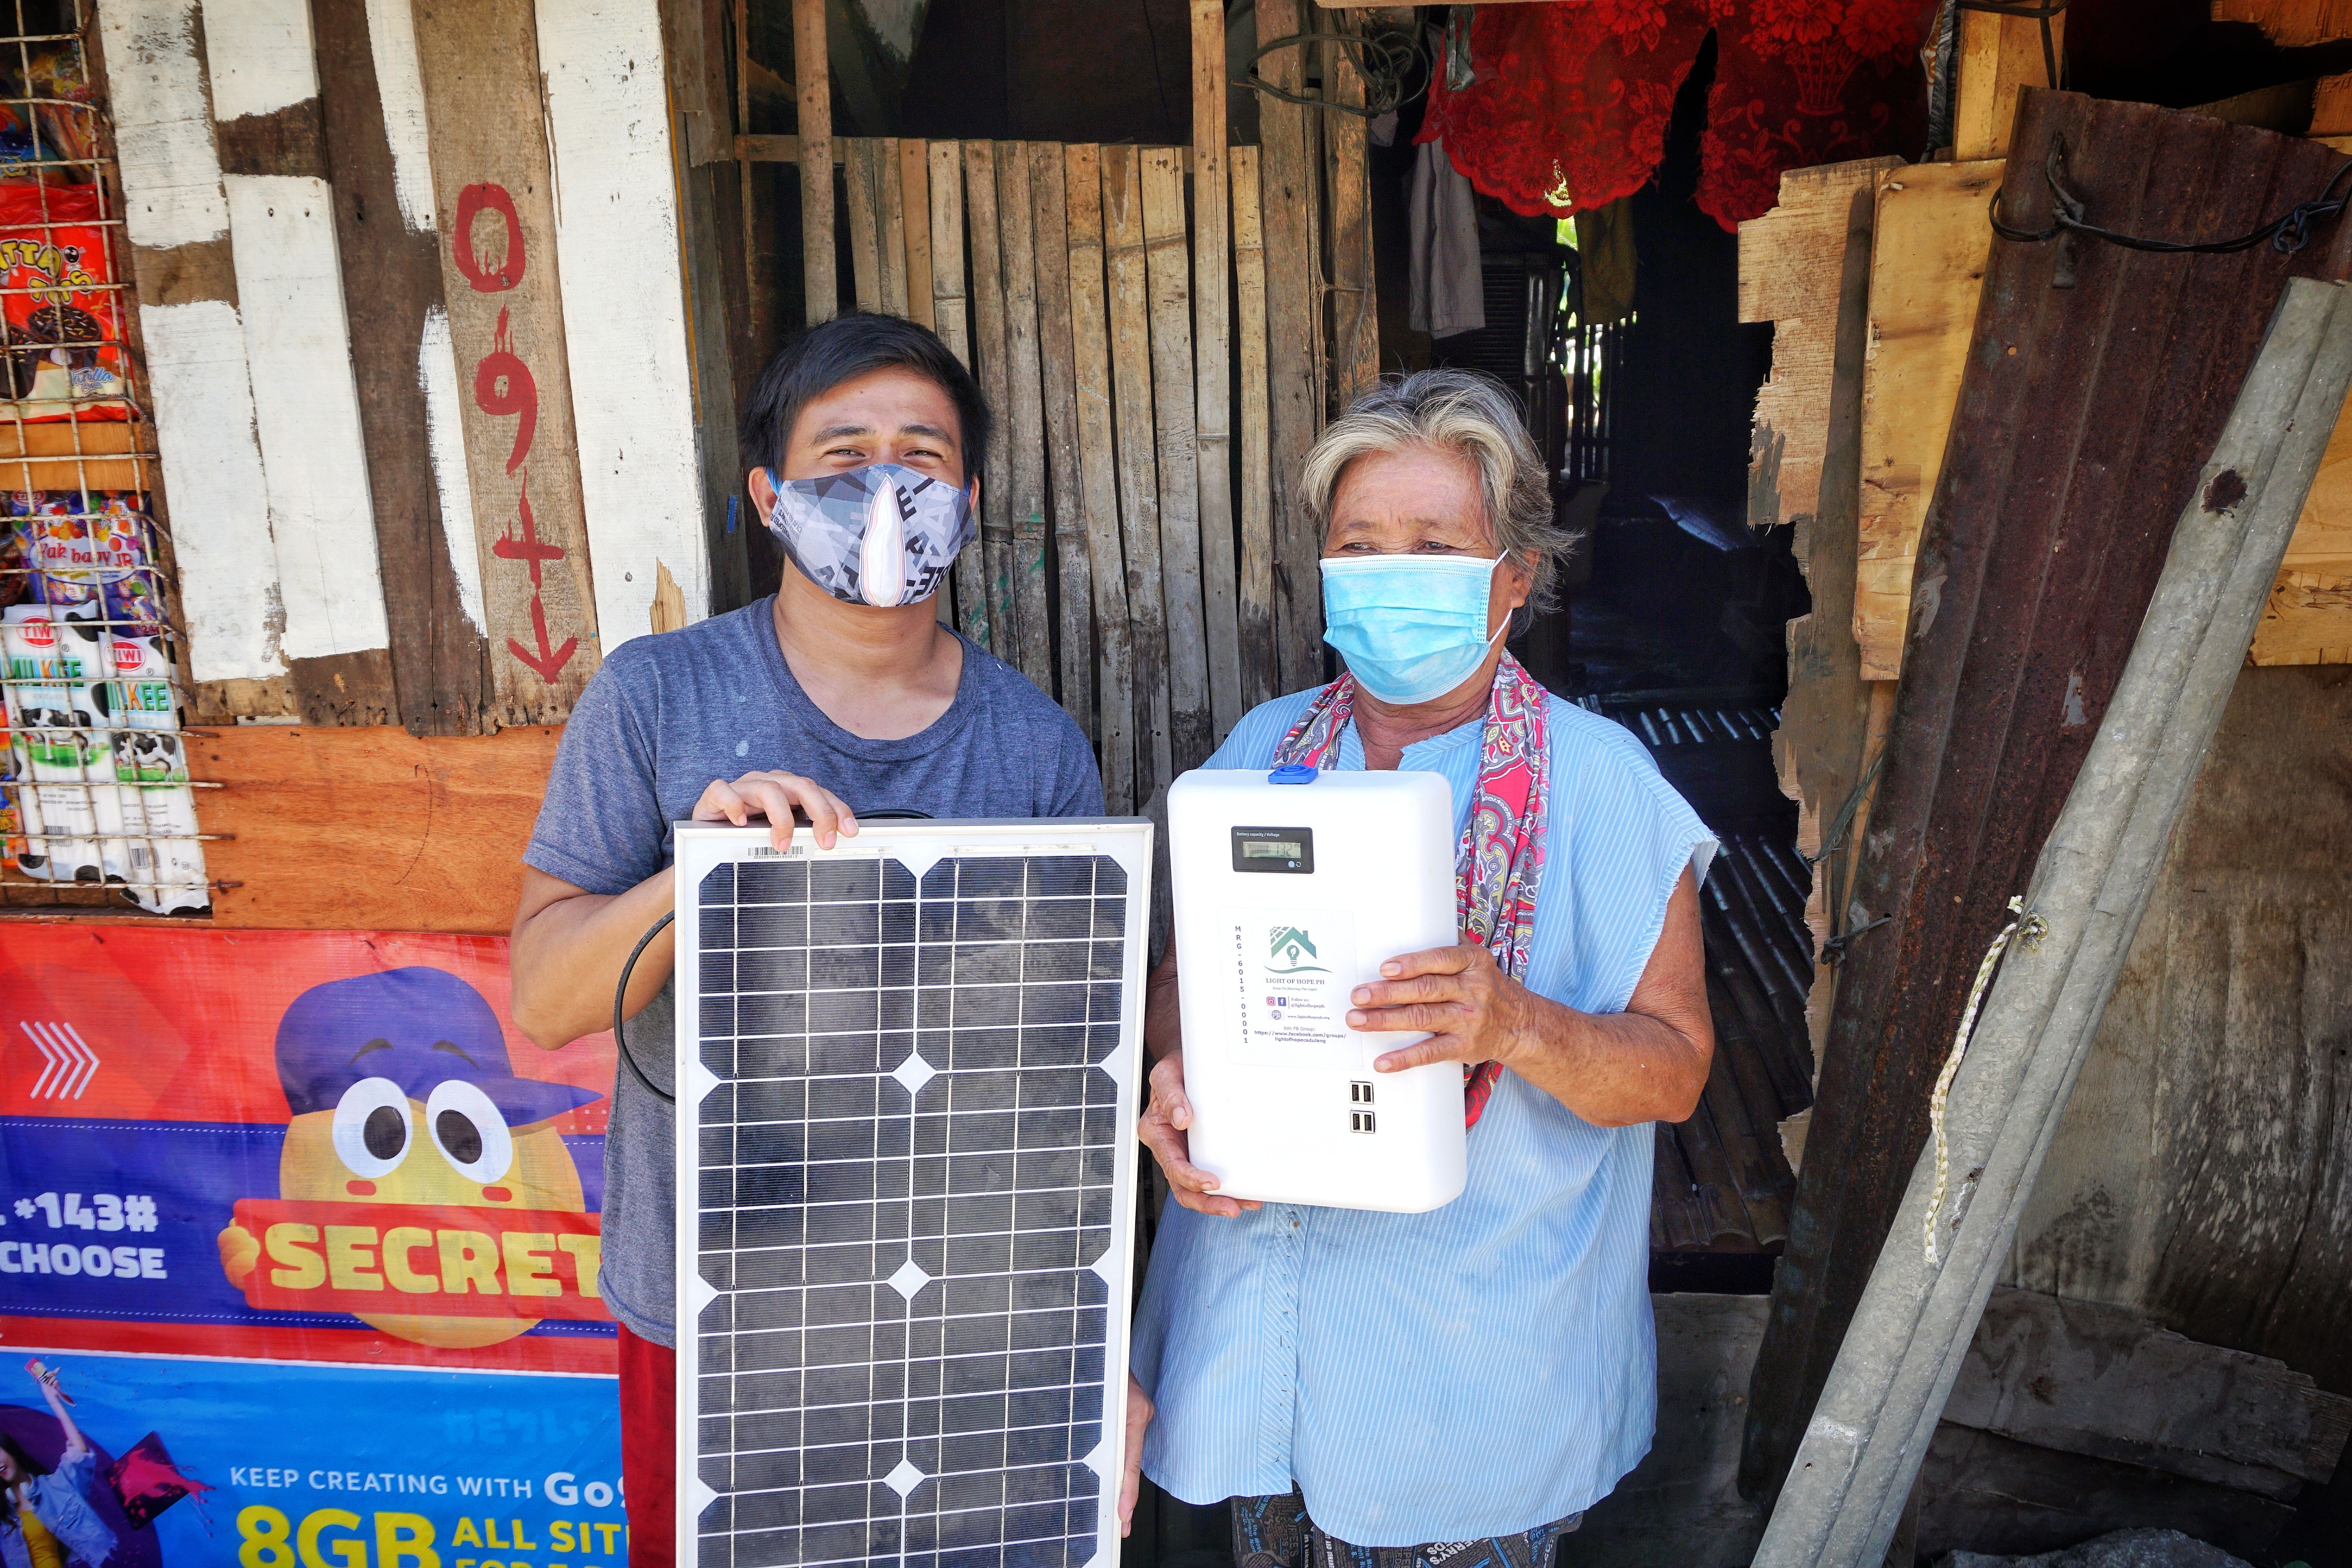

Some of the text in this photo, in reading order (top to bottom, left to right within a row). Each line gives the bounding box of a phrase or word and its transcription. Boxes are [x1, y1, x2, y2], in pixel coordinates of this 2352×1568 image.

[0, 239, 61, 279] TTA
[71, 367, 115, 386] anilla
[24, 626, 56, 639] TIW
[108, 648, 142, 662] IWI
[105, 682, 169, 711] ILKEE
[0, 1241, 167, 1279] CHOOSE
[265, 1222, 601, 1299] SECRET
[230, 1466, 299, 1488] KEEP
[308, 1470, 448, 1495] CREATING
[456, 1477, 532, 1499] WITH
[236, 1504, 441, 1568] 8GB
[451, 1517, 630, 1555] ALL SIT
